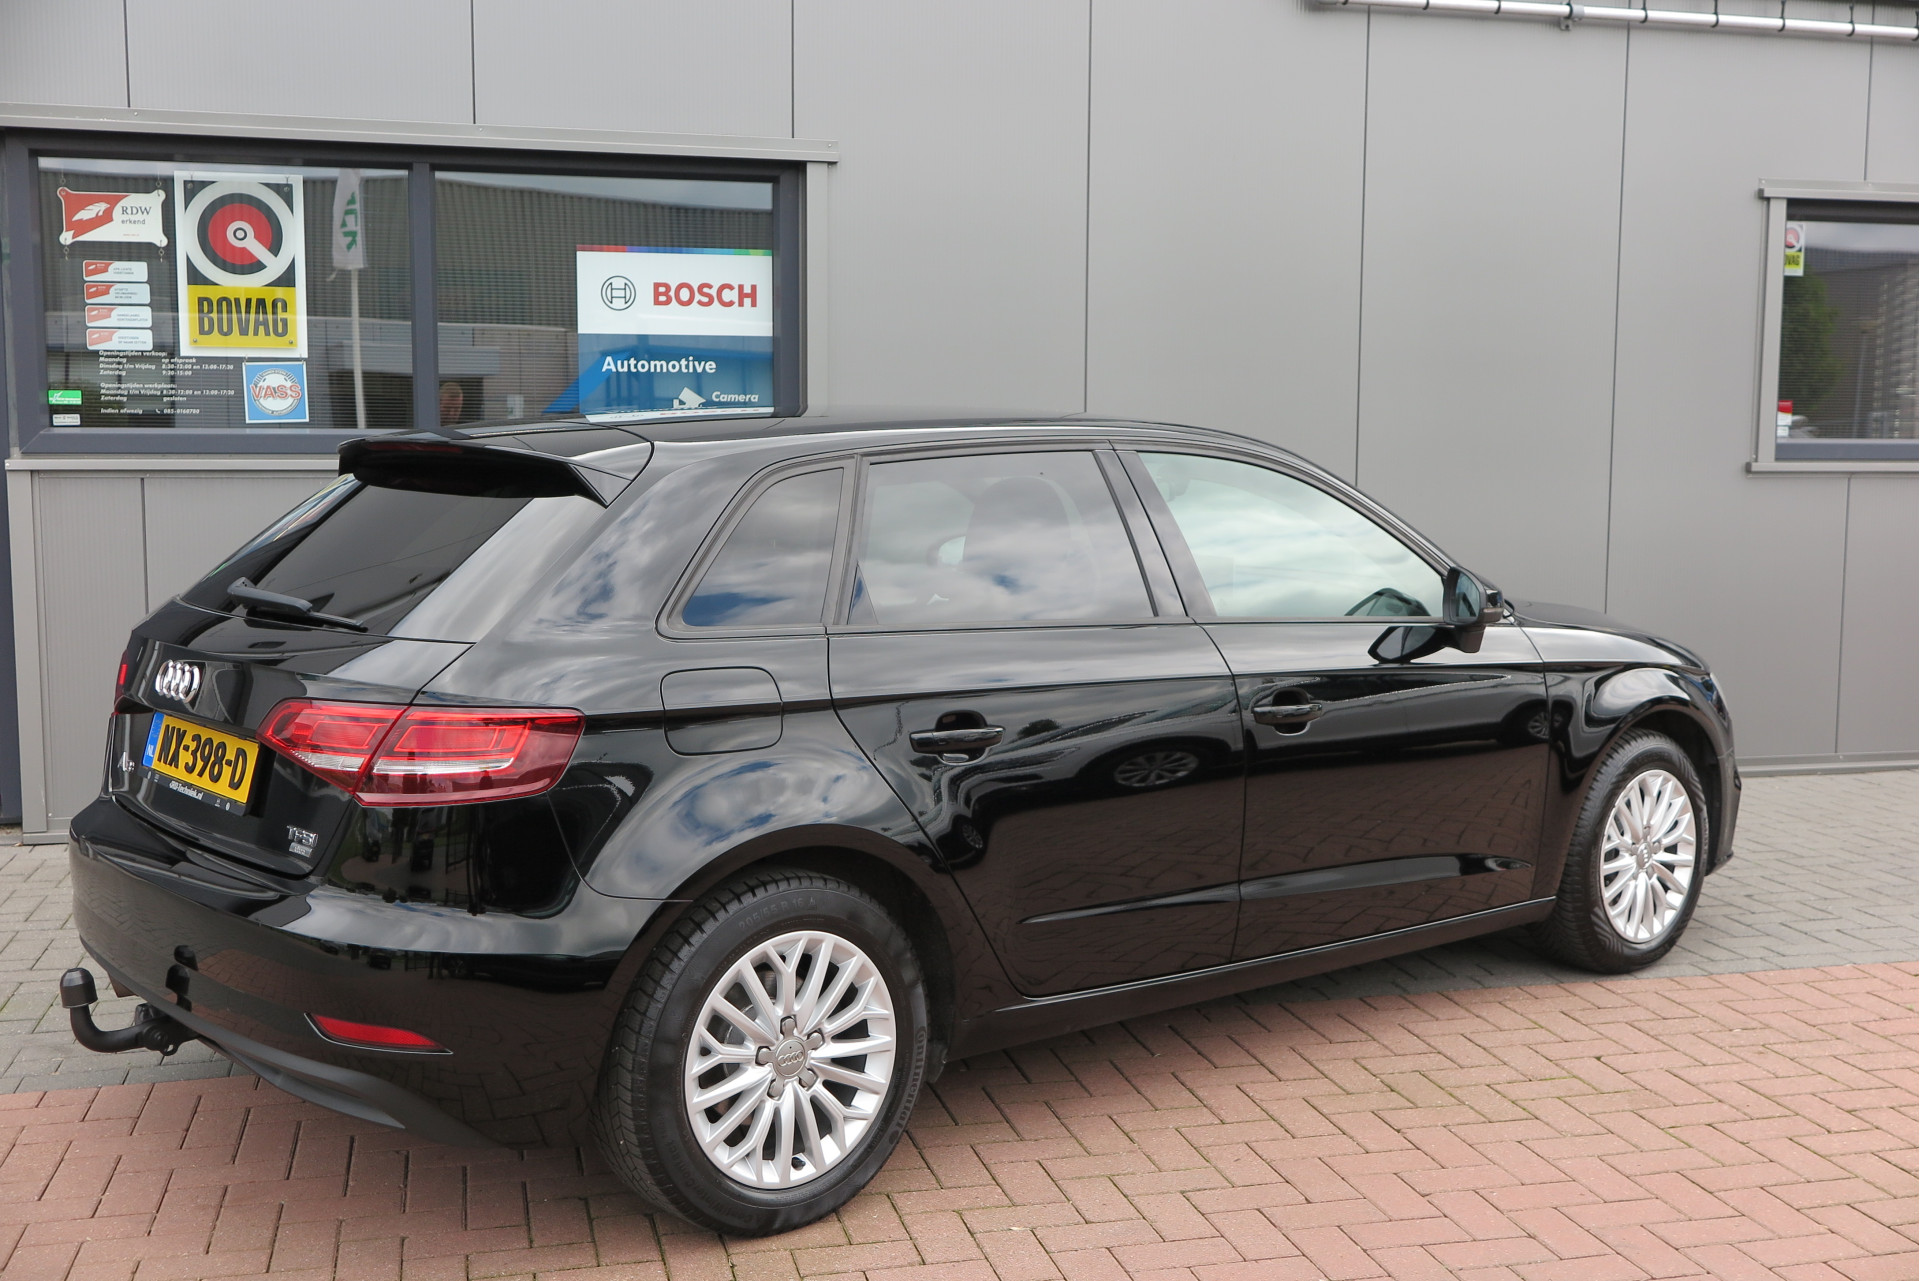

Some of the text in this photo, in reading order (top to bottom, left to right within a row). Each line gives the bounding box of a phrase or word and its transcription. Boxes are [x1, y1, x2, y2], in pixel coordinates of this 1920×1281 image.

[121, 205, 152, 216] RDW
[653, 282, 757, 308] BOSCH
[197, 296, 289, 337] BOVAG
[601, 356, 717, 374] Automotive
[250, 384, 303, 401] VASS
[712, 391, 759, 403] Camera
[157, 724, 247, 790] NX-398-D
